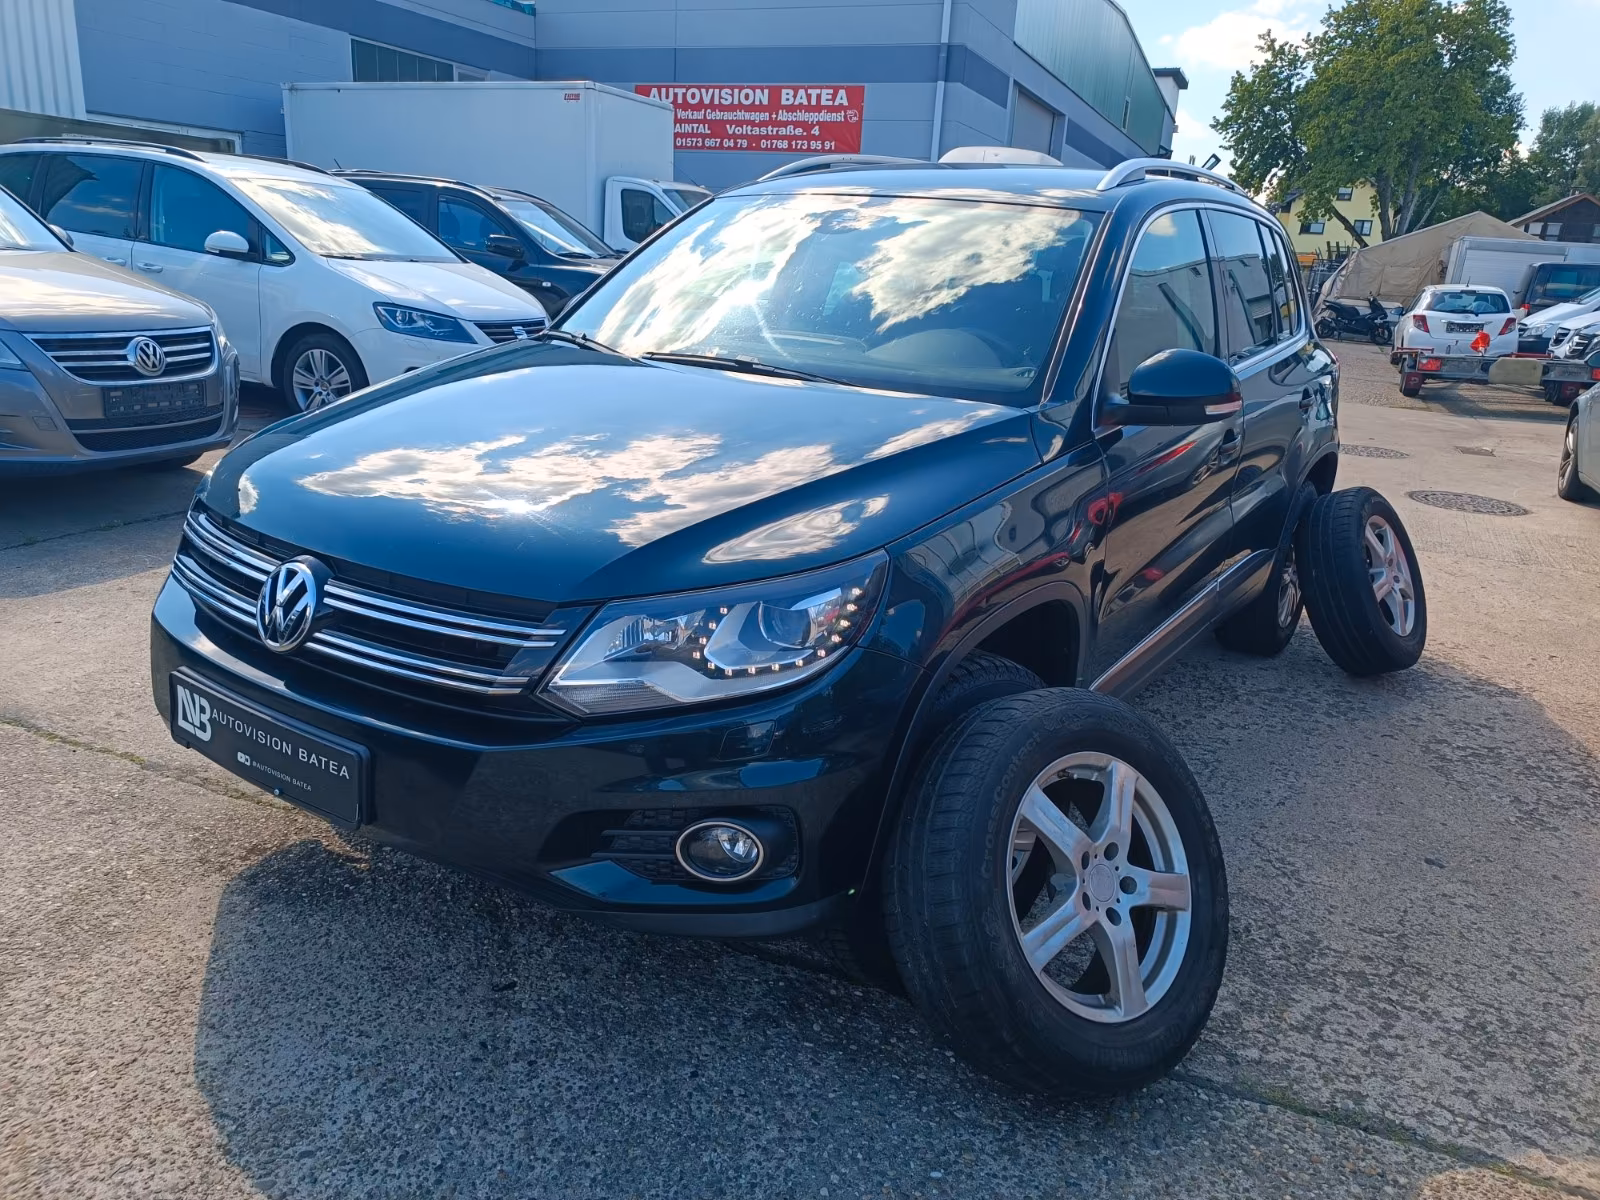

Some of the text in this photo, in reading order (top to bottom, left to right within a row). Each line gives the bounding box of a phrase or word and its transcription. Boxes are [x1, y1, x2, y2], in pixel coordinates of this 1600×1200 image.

[649, 88, 849, 106] AUTOVISION BATEA
[676, 108, 705, 120] Verkauf
[706, 109, 769, 123] Gebrauchtwagen
[674, 123, 711, 134] AINTAL
[811, 125, 820, 136] 4
[676, 137, 835, 150] 01573 667 04 79 01768 173 95 91
[212, 708, 350, 780] AUTOVISION BATEA
[292, 778, 312, 792] BATEA
